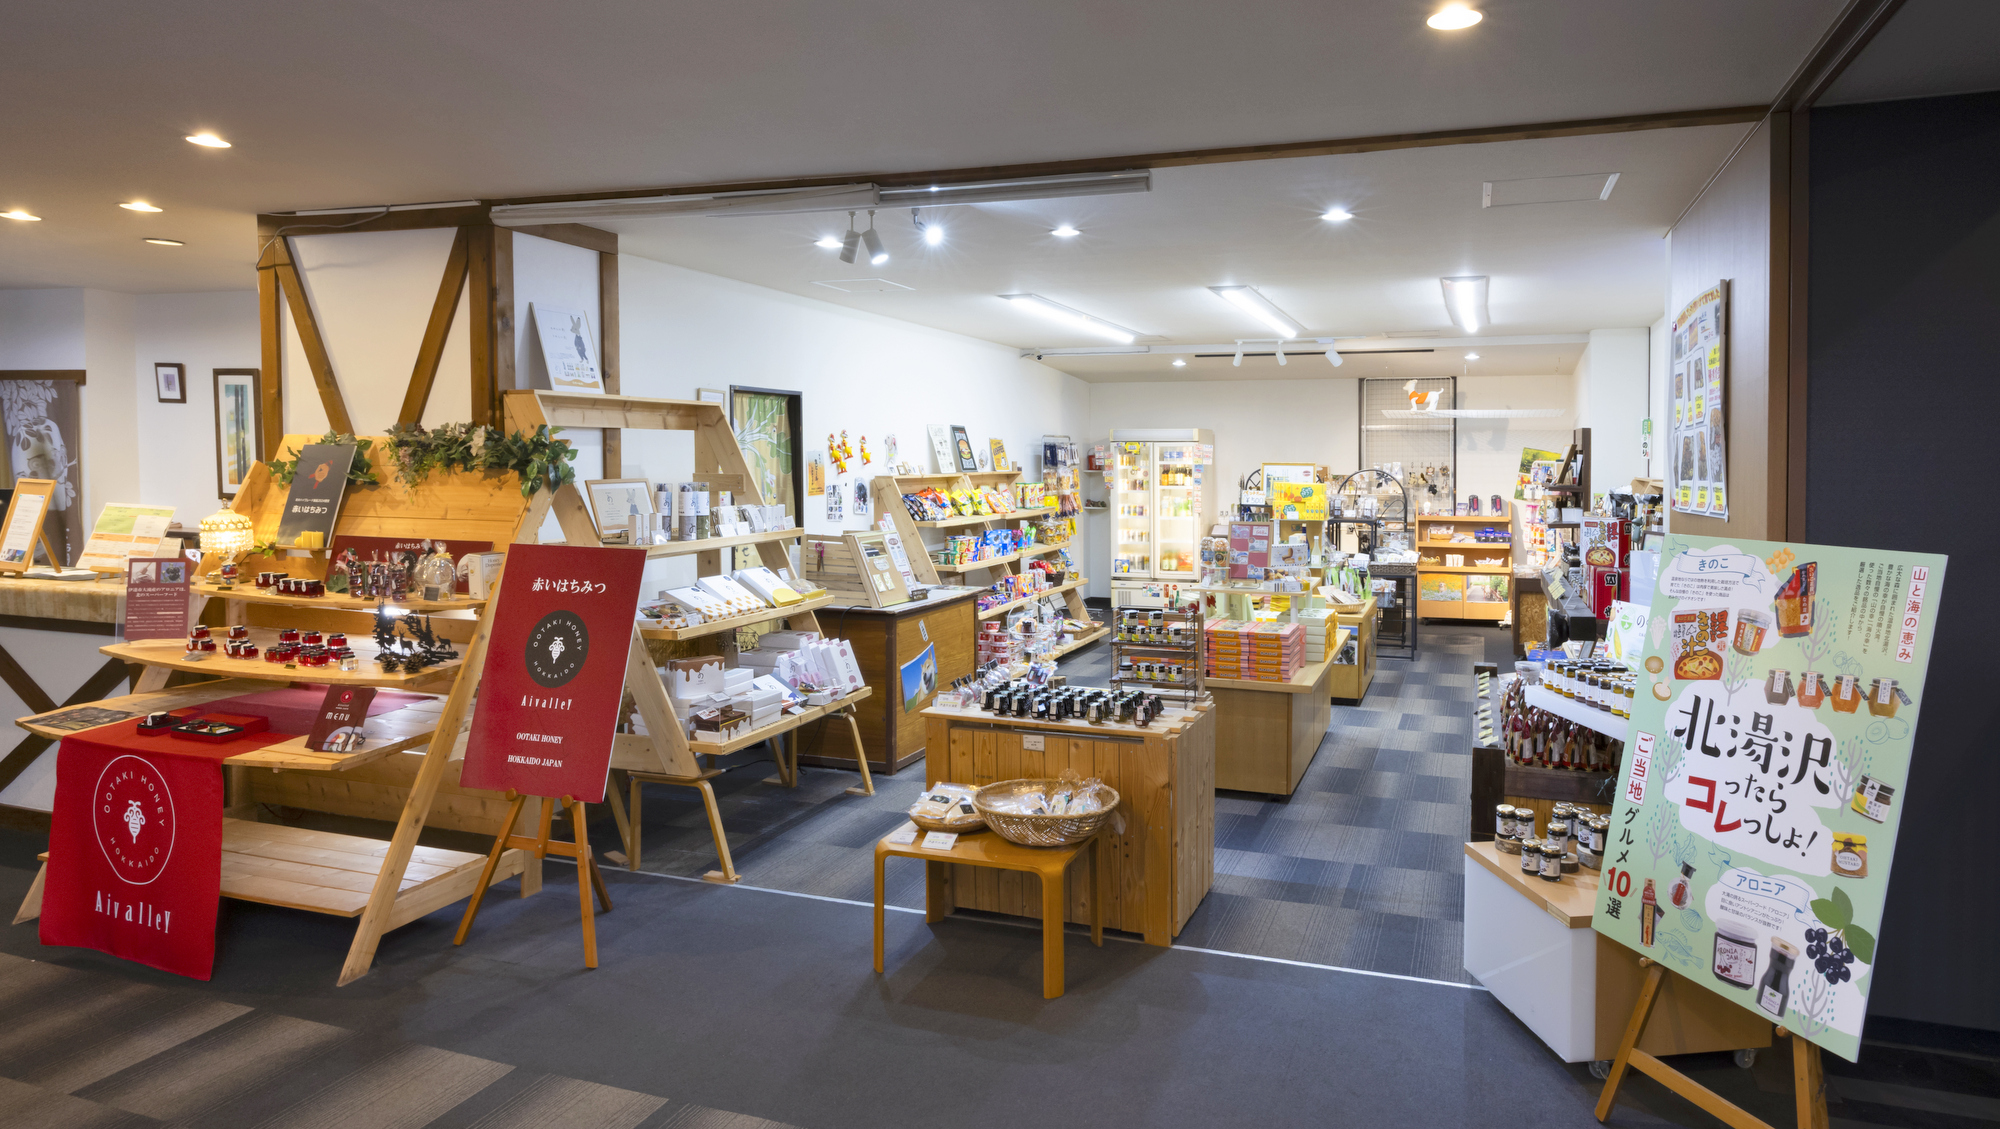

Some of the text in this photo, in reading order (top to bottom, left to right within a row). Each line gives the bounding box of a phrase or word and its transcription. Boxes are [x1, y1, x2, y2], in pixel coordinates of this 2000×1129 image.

[291, 505, 328, 514] 赤いはちみつ
[394, 542, 423, 550] 赤いはちみ
[1698, 558, 1729, 571] きのこ
[531, 577, 607, 594] 赤いはちみつ
[1716, 610, 1728, 638] 日本一
[1898, 568, 1926, 661] 山と海の恵み
[533, 618, 583, 651] OOTAKI HONEY
[533, 660, 576, 679] HOKKAIDO
[325, 712, 351, 721] MENU
[516, 733, 564, 745] OOTAKI HONEY
[1674, 694, 1833, 795] 北湯沢
[507, 755, 563, 768] HOKKAIDO JAPAN
[104, 771, 166, 828] OOTAKI HONEY
[1725, 774, 1788, 814] ったら
[111, 836, 160, 868] HOKKAIDO
[1736, 874, 1786, 896] アロニア
